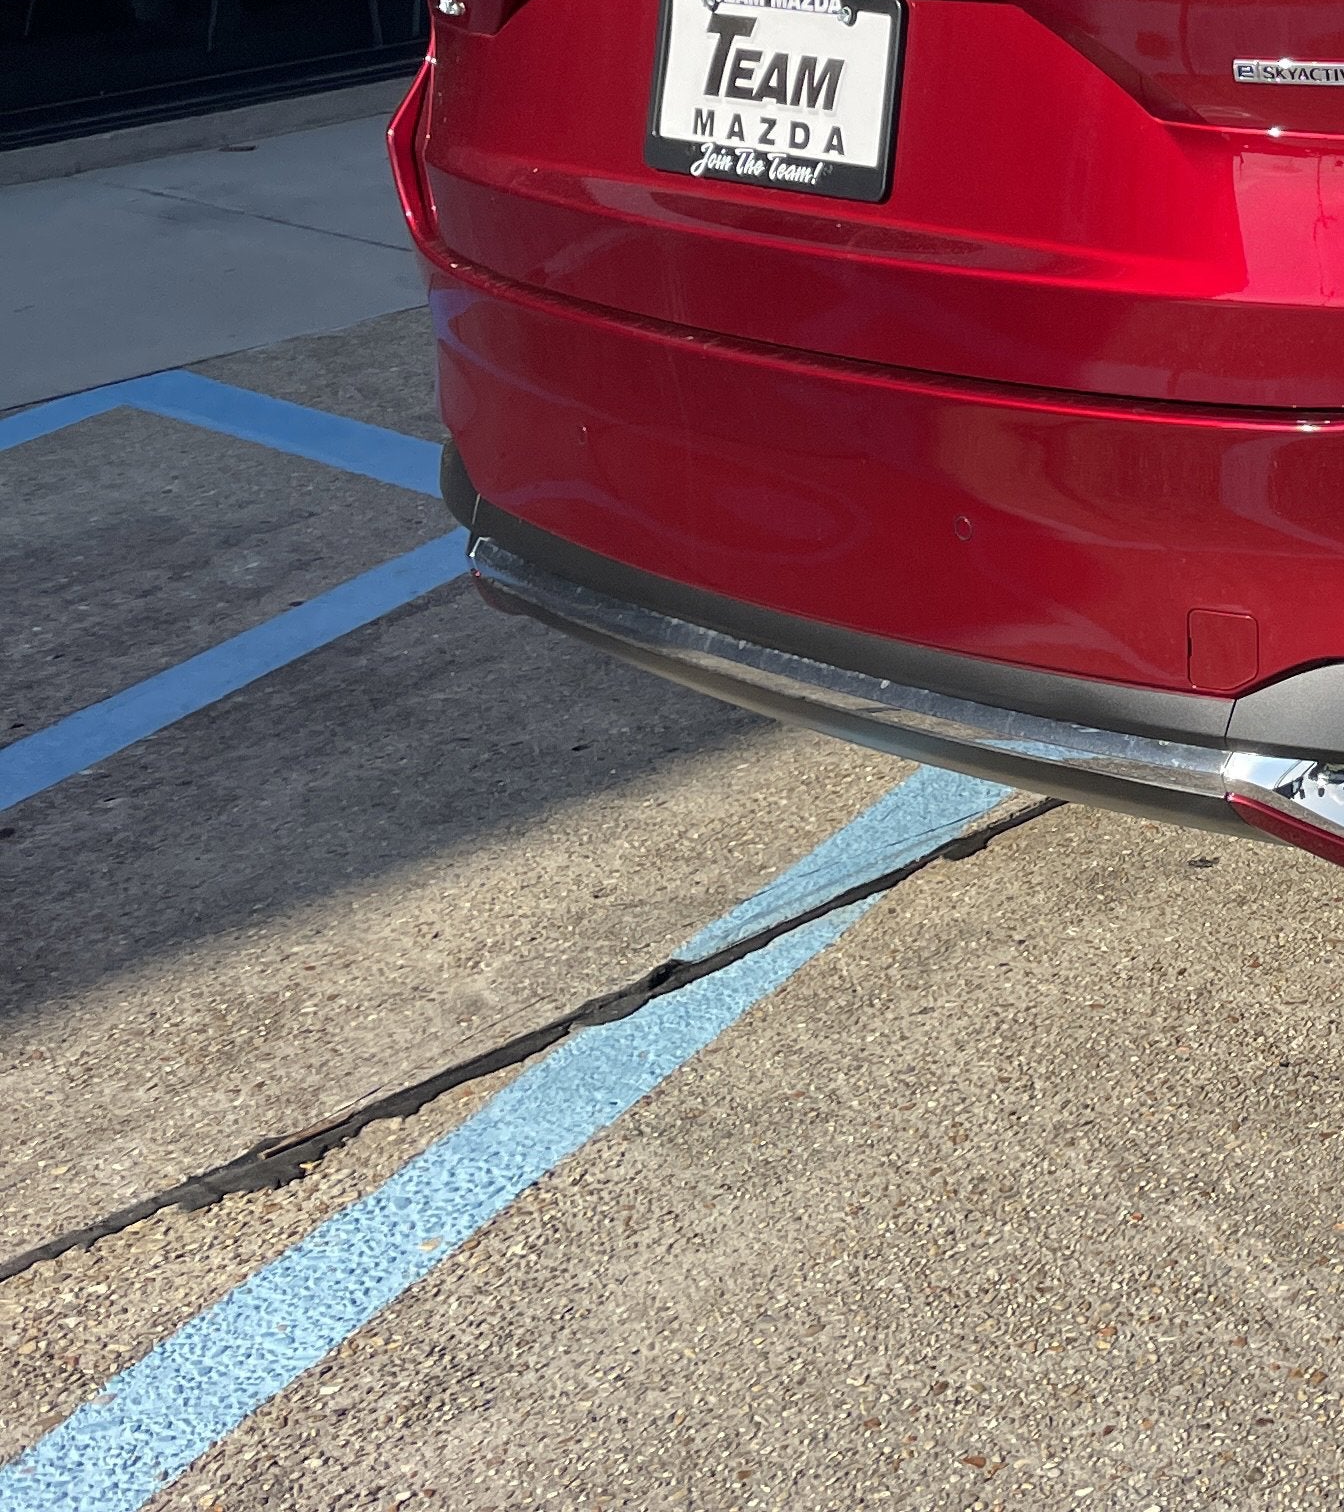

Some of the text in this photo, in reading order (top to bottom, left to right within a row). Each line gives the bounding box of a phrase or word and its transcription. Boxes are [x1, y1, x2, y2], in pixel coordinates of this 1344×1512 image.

[703, 13, 845, 111] TEAM
[692, 107, 845, 155] MAZDA
[690, 142, 823, 185] Join The Team!
